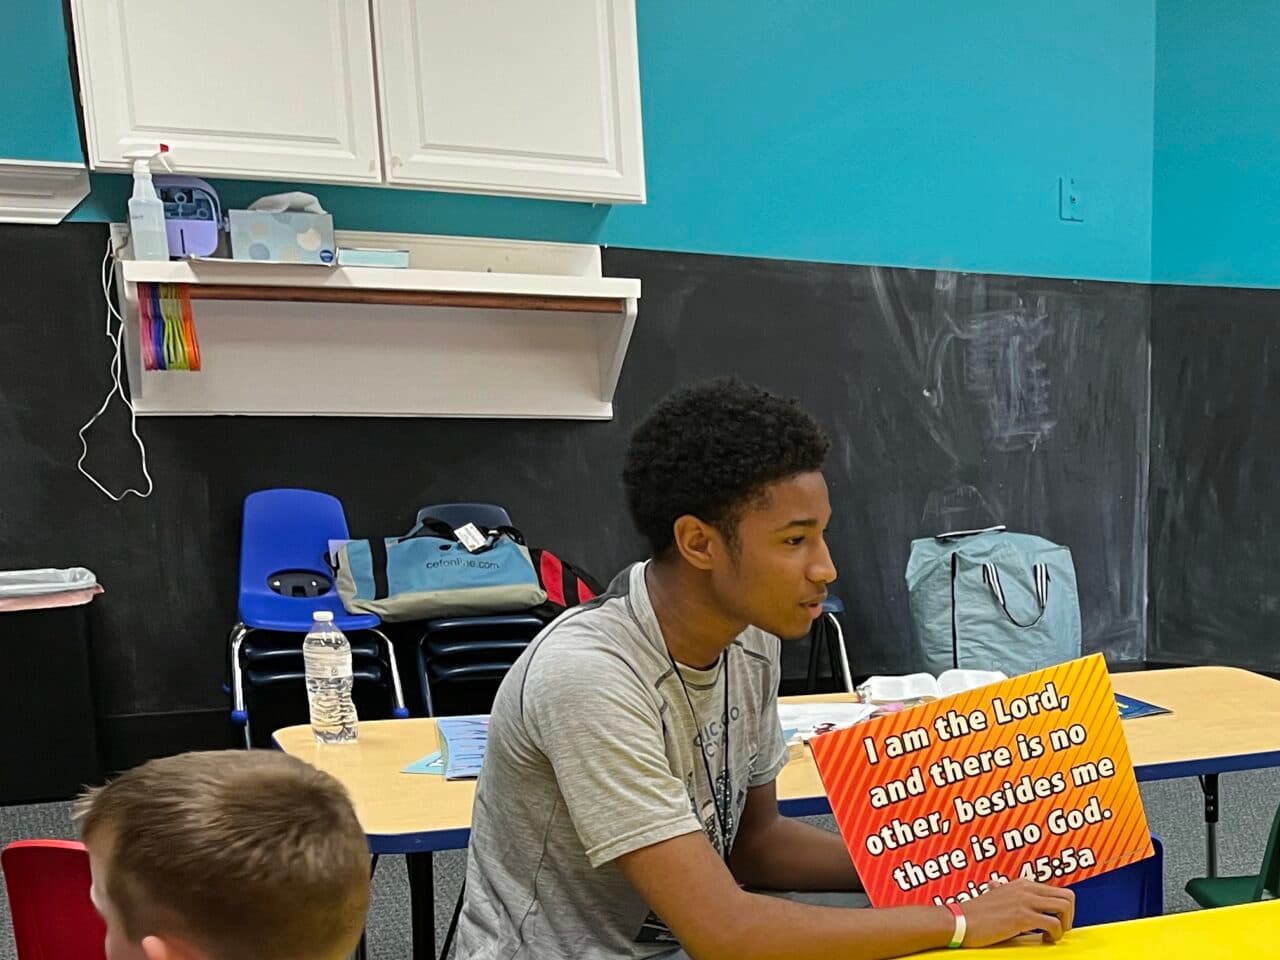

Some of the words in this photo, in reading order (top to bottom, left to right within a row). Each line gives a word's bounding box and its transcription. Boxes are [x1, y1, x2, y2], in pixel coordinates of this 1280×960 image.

[863, 736, 879, 764] I
[885, 726, 931, 759] am
[934, 709, 988, 741] the
[992, 682, 1069, 725] Lord,
[869, 768, 926, 809] and
[930, 744, 1012, 788] there
[1016, 734, 1044, 761] is
[1050, 723, 1087, 751] no
[865, 810, 950, 856] other,
[954, 771, 1066, 825] besides
[1071, 756, 1115, 788] me
[893, 847, 968, 891] there
[970, 835, 998, 862] is
[1002, 823, 1042, 852] no
[1047, 796, 1113, 835] God.
[1019, 847, 1096, 883] 45:5a
